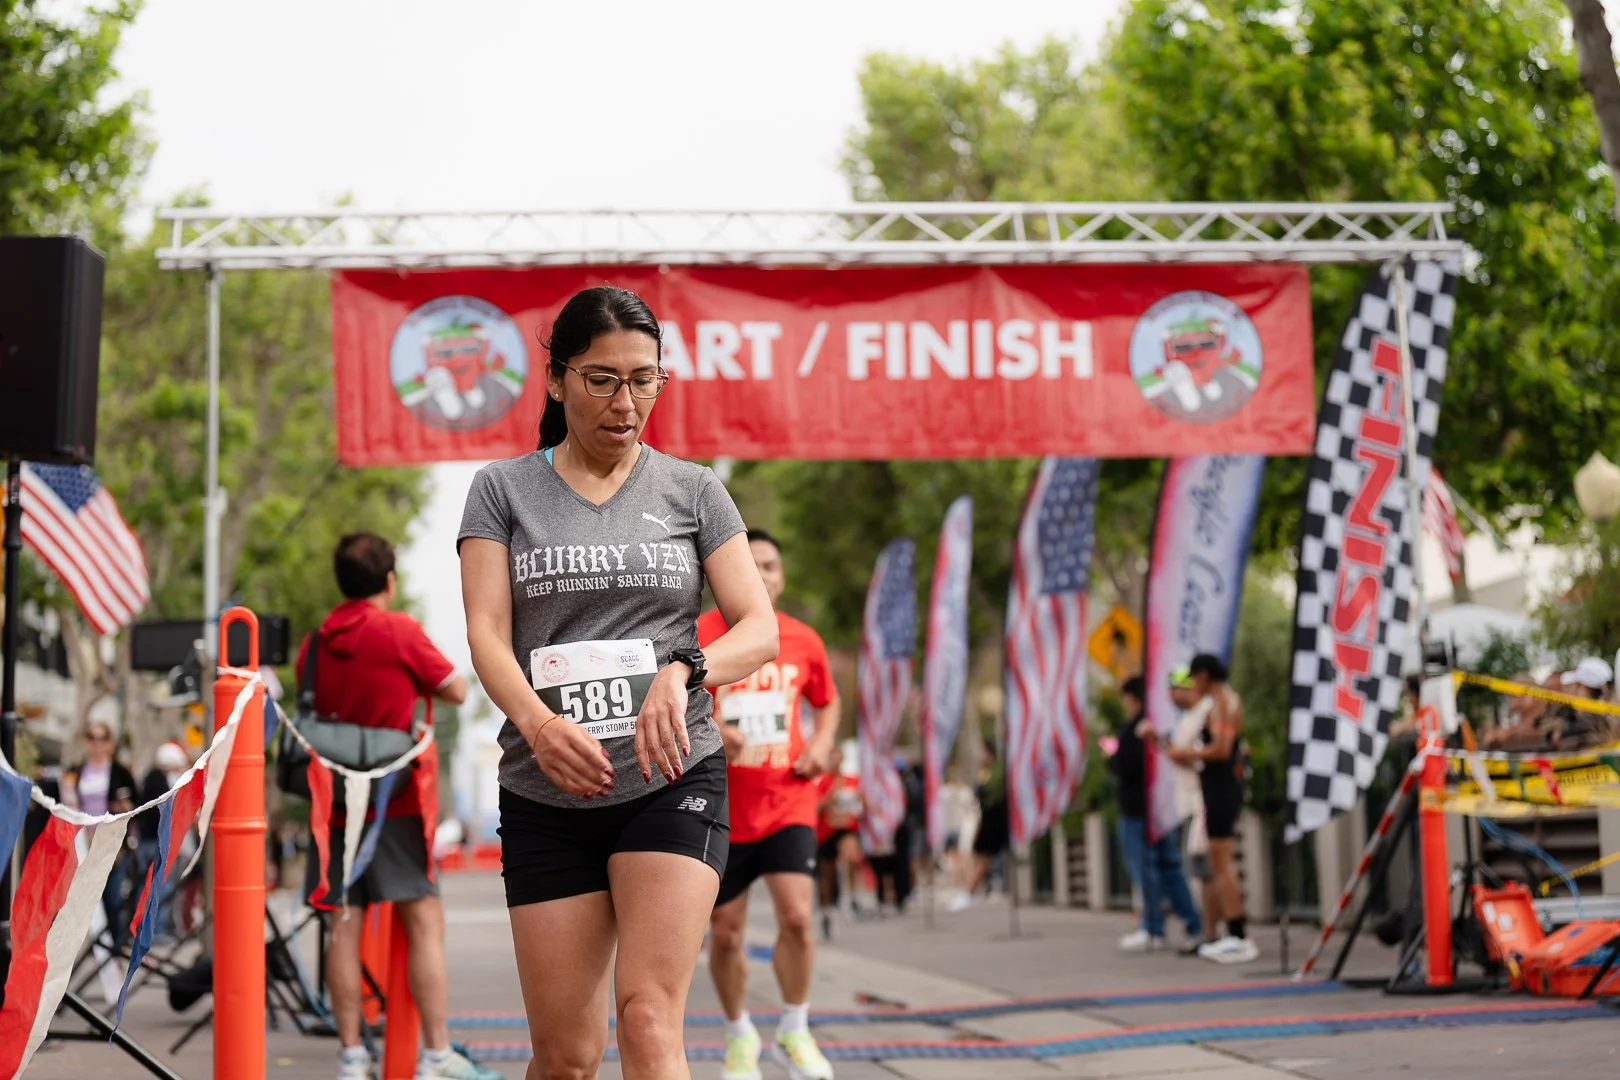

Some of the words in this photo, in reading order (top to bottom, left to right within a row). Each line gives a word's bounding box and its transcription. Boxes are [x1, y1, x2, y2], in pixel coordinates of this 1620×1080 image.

[659, 320, 782, 380] ART
[797, 320, 829, 379] /
[847, 319, 1093, 380] FINISH
[1333, 338, 1406, 726] FINISH
[515, 544, 630, 583] BLURRY
[639, 543, 691, 574] VZN
[526, 581, 553, 598] KEEP
[556, 576, 614, 593] RUNNIN'
[617, 573, 659, 588] SANTA
[661, 576, 683, 590] ANA
[560, 678, 633, 724] 589
[586, 725, 605, 735] ERRY
[605, 722, 629, 733] STOMP
[630, 721, 637, 730] 5
